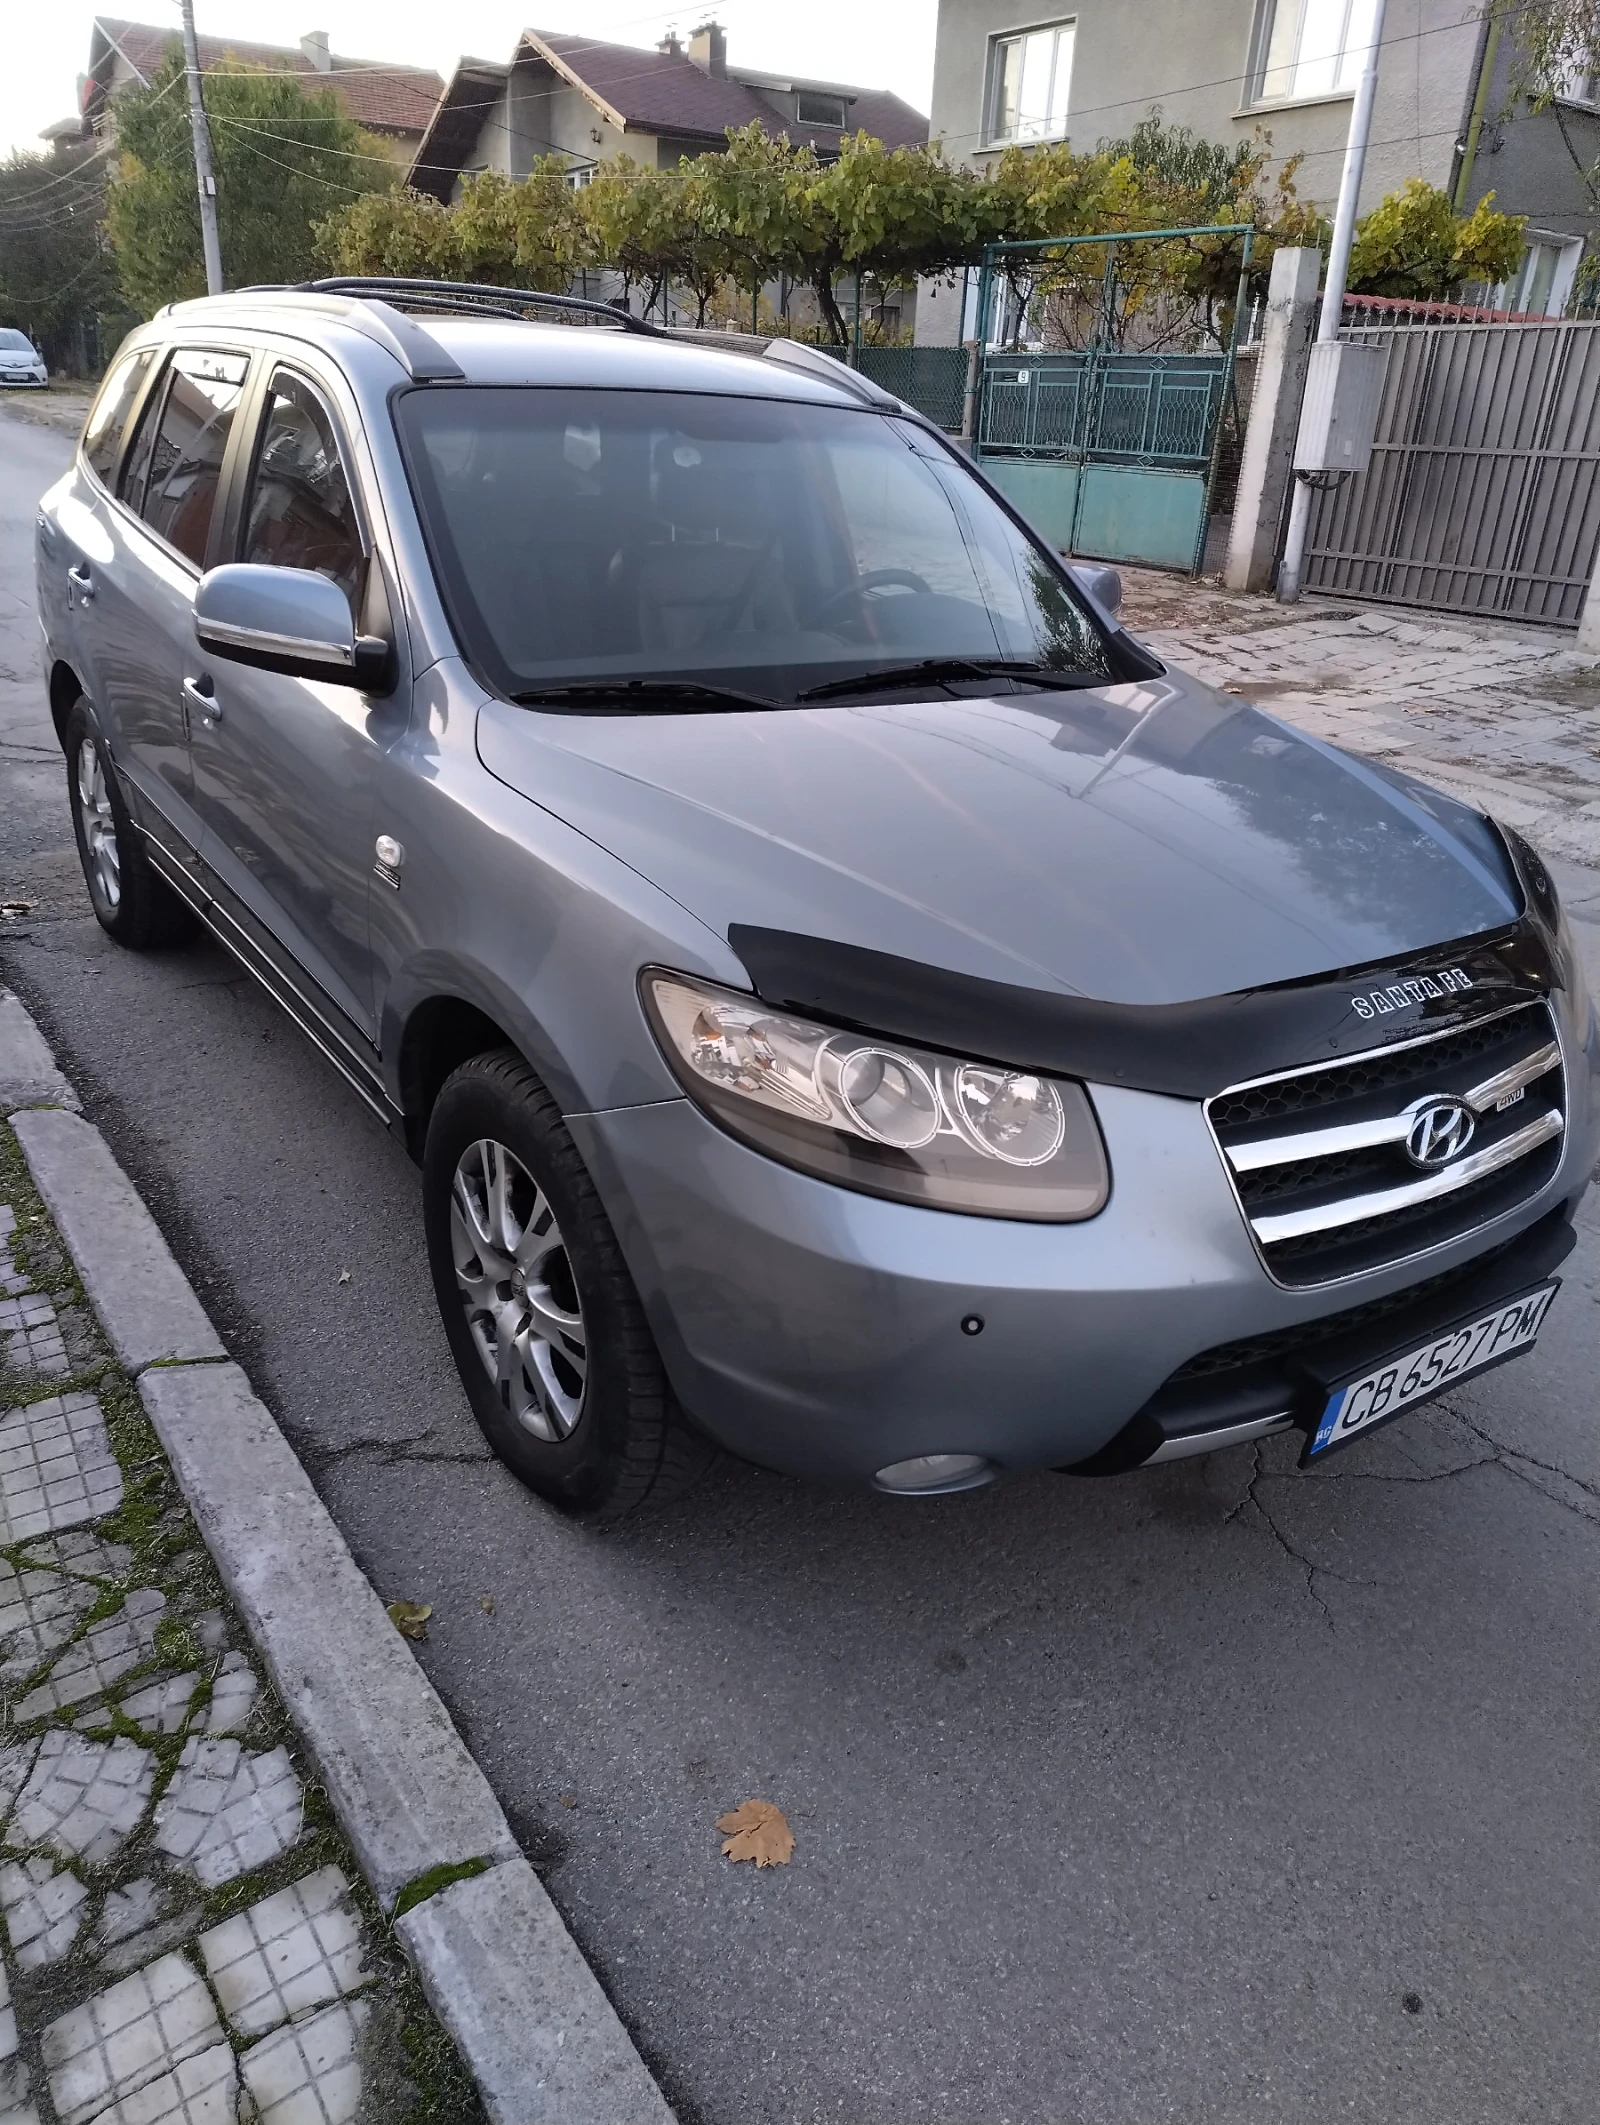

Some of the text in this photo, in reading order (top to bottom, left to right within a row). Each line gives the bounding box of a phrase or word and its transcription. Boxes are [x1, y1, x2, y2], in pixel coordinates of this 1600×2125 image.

[1020, 371, 1027, 382] 9
[1351, 968, 1474, 1019] SANTA FE
[1499, 1088, 1522, 1107] 4WD
[1313, 1425, 1333, 1446] BG
